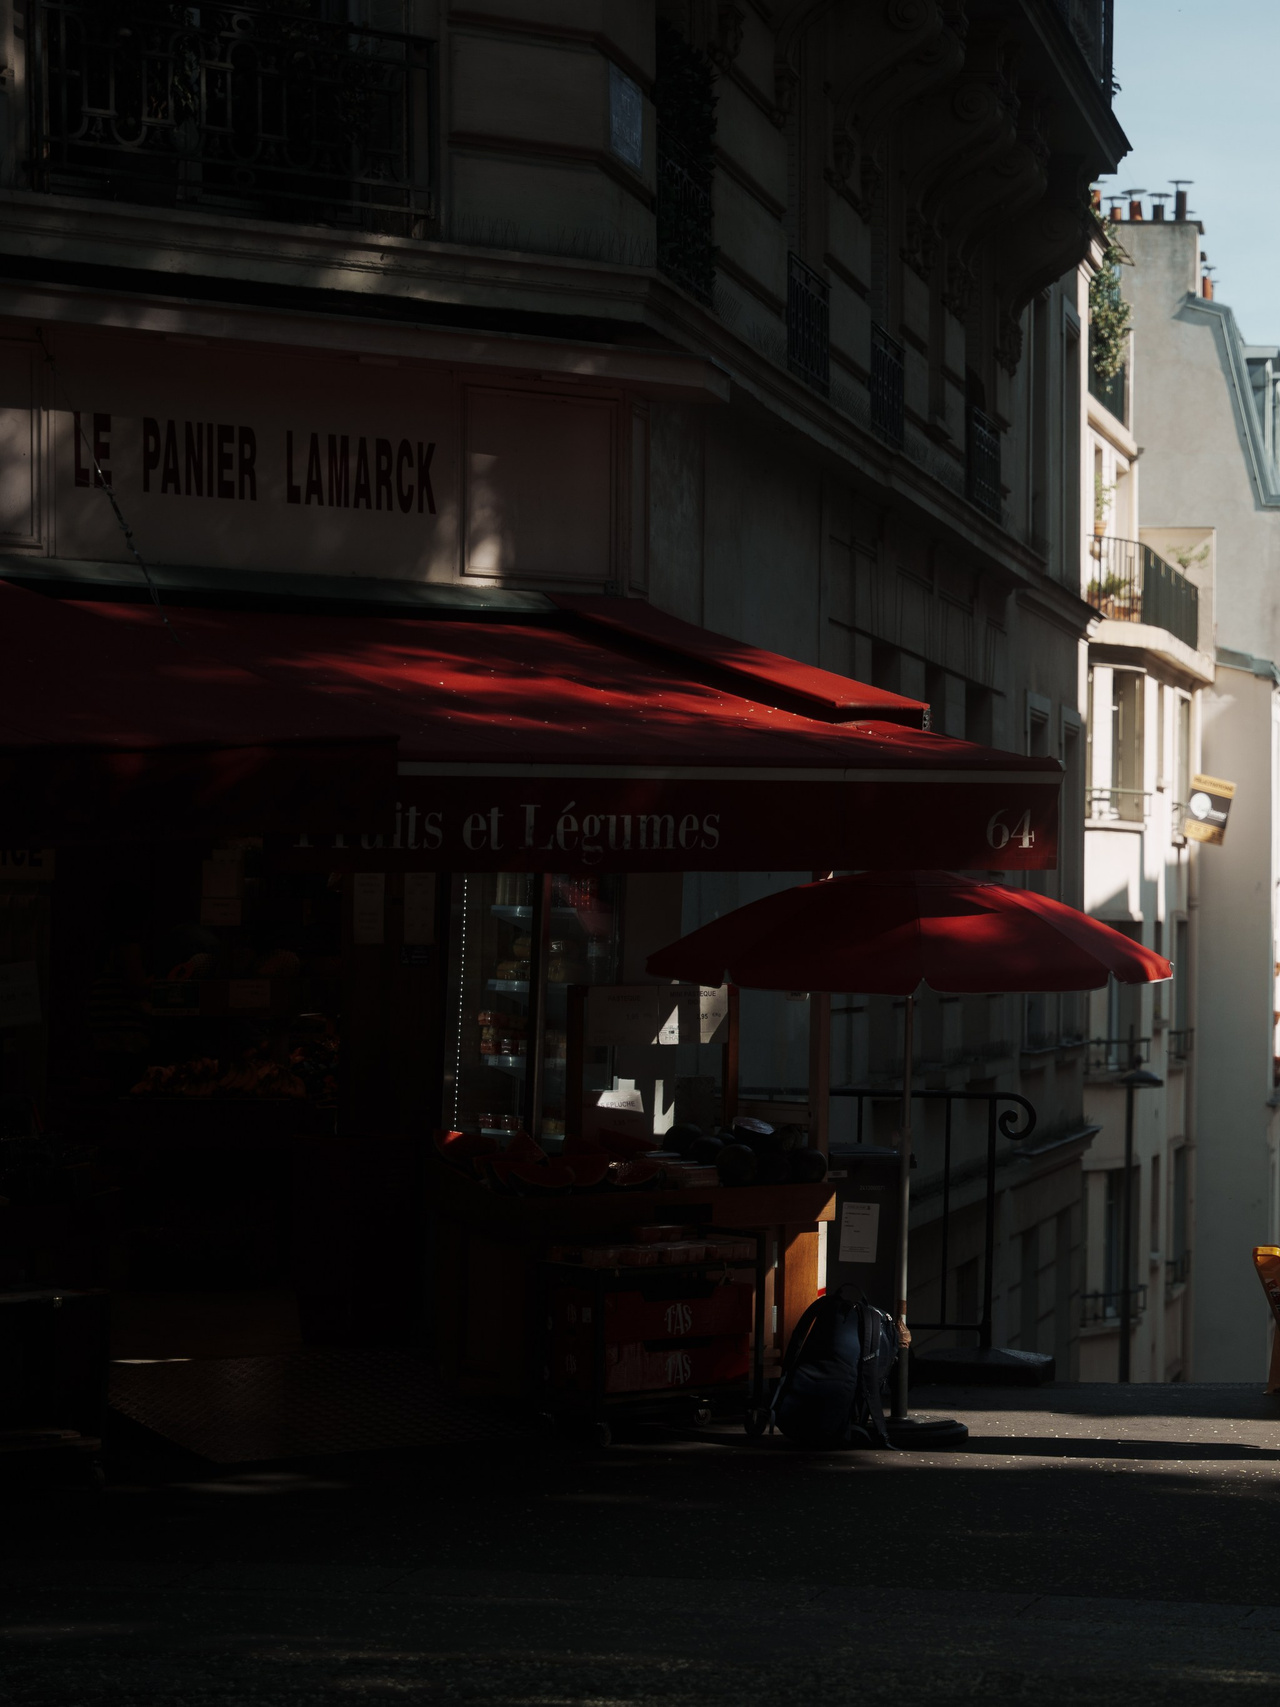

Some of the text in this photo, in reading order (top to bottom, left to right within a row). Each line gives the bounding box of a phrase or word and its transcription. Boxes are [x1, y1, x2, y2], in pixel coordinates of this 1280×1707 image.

[75, 411, 437, 514] LE PANIER LAMARCK
[462, 808, 503, 851] et
[518, 800, 721, 865] Légumes
[986, 808, 1035, 849] 64
[664, 1302, 694, 1335] TAS
[665, 1349, 693, 1385] TAS
